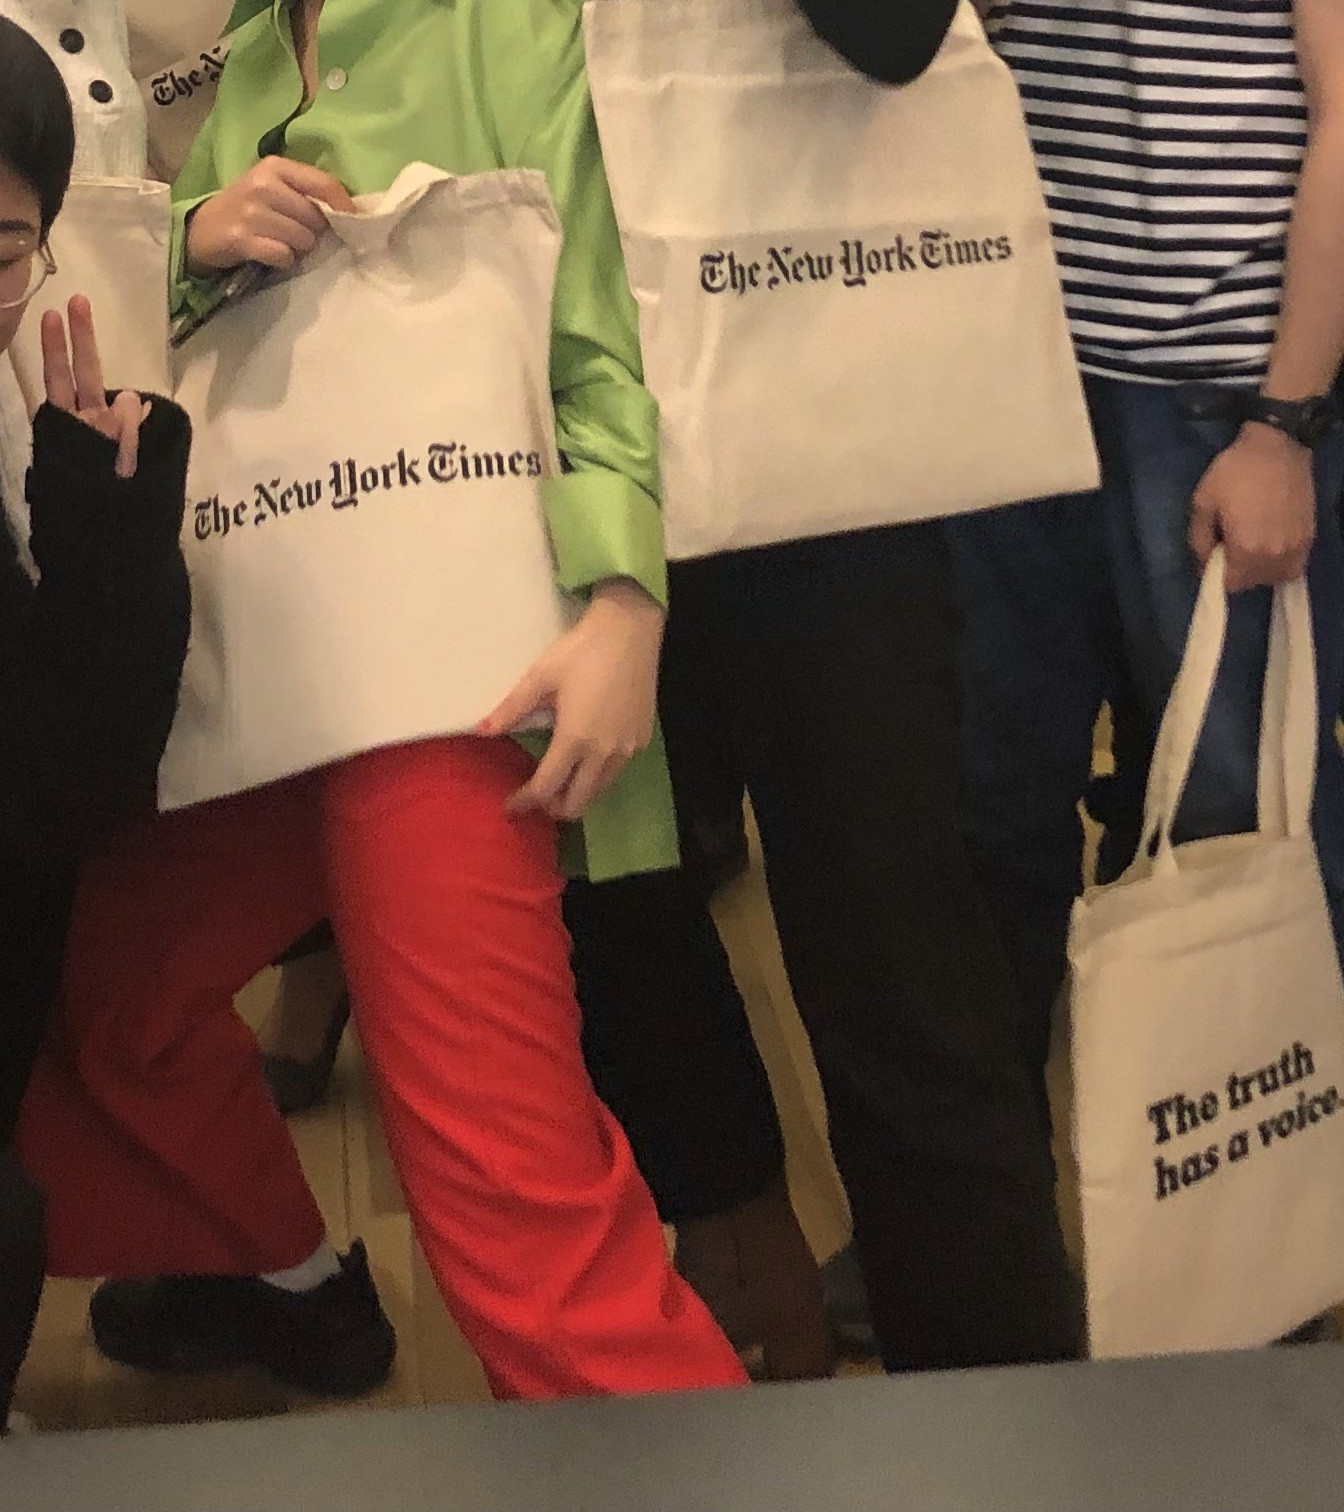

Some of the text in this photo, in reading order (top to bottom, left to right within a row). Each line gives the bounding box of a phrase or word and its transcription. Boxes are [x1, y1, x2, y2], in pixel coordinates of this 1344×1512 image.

[151, 70, 205, 106] The
[700, 229, 1013, 296] The New York Times
[194, 441, 542, 541] The New York Times
[1147, 1040, 1315, 1145] The truth
[1153, 1142, 1220, 1202] has
[1227, 1129, 1249, 1163] a
